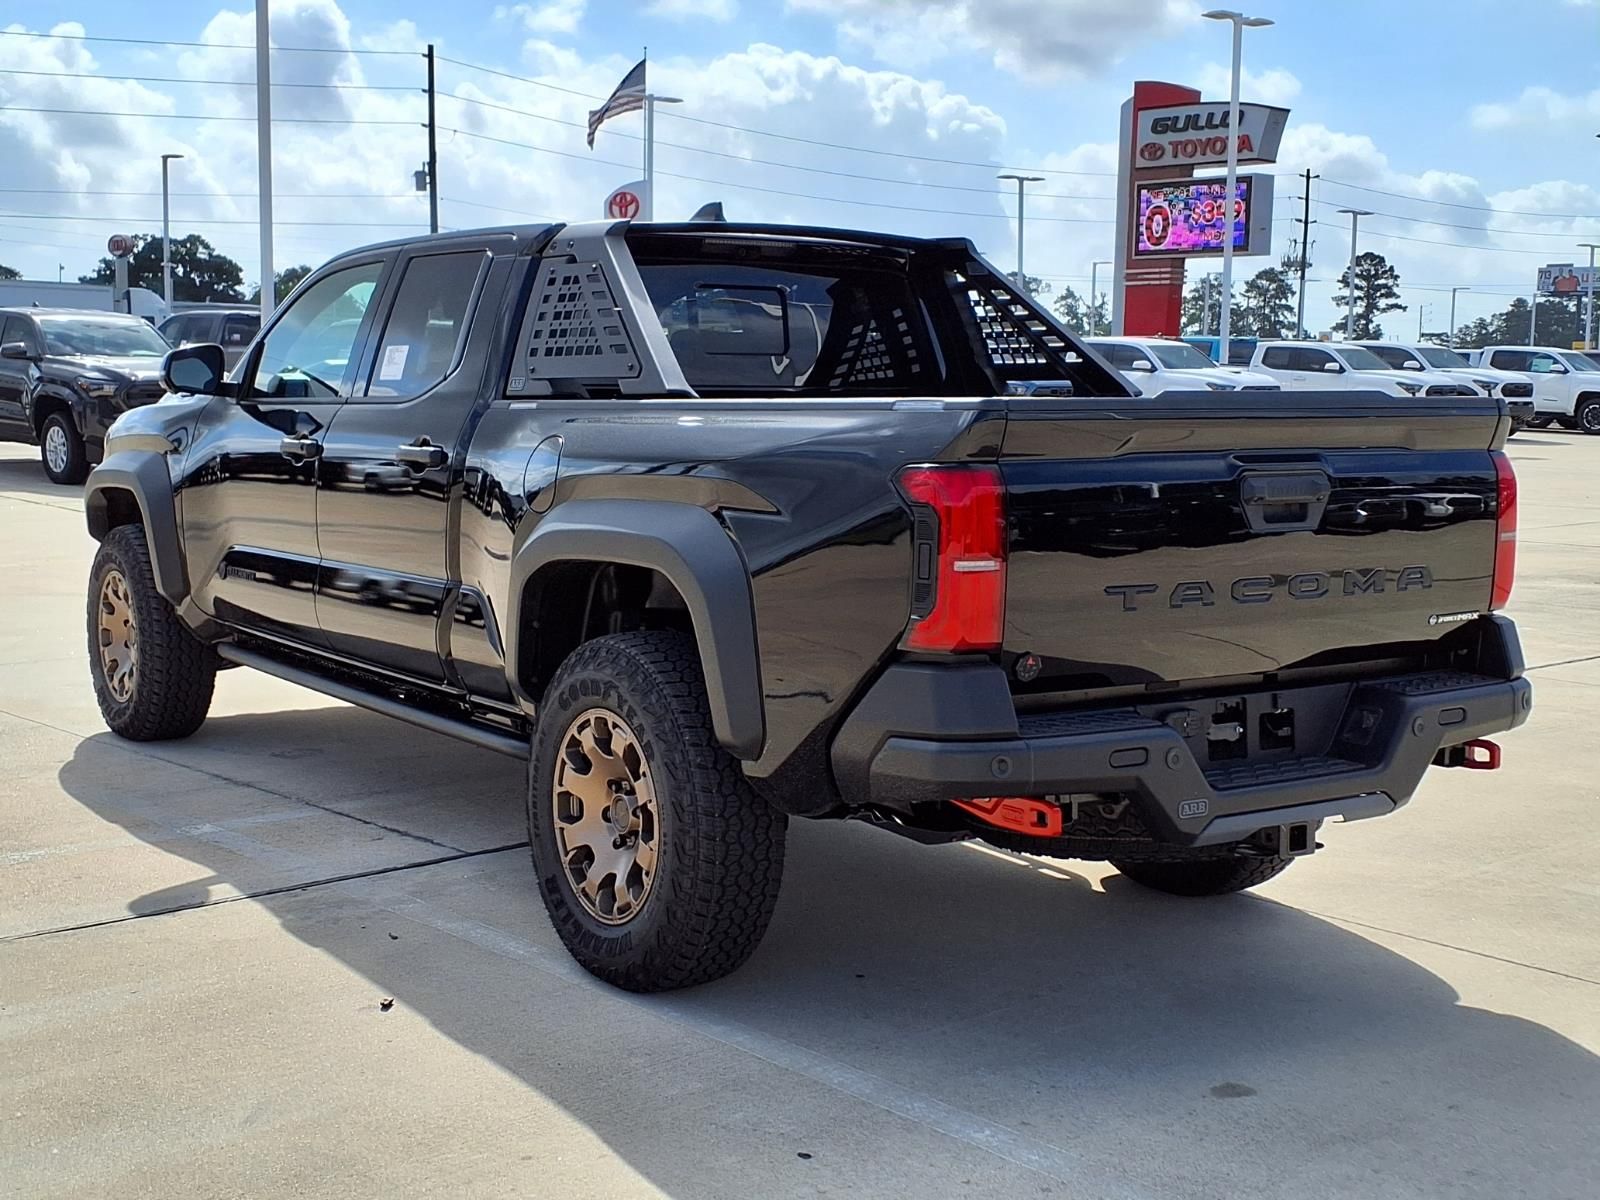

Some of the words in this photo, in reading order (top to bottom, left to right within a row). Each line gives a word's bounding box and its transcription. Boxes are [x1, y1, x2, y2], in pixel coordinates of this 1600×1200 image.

[1150, 109, 1245, 135] GULLO
[1168, 134, 1254, 159] TOYOA
[1104, 565, 1433, 611] TACOMA
[1182, 801, 1206, 816] ARB
